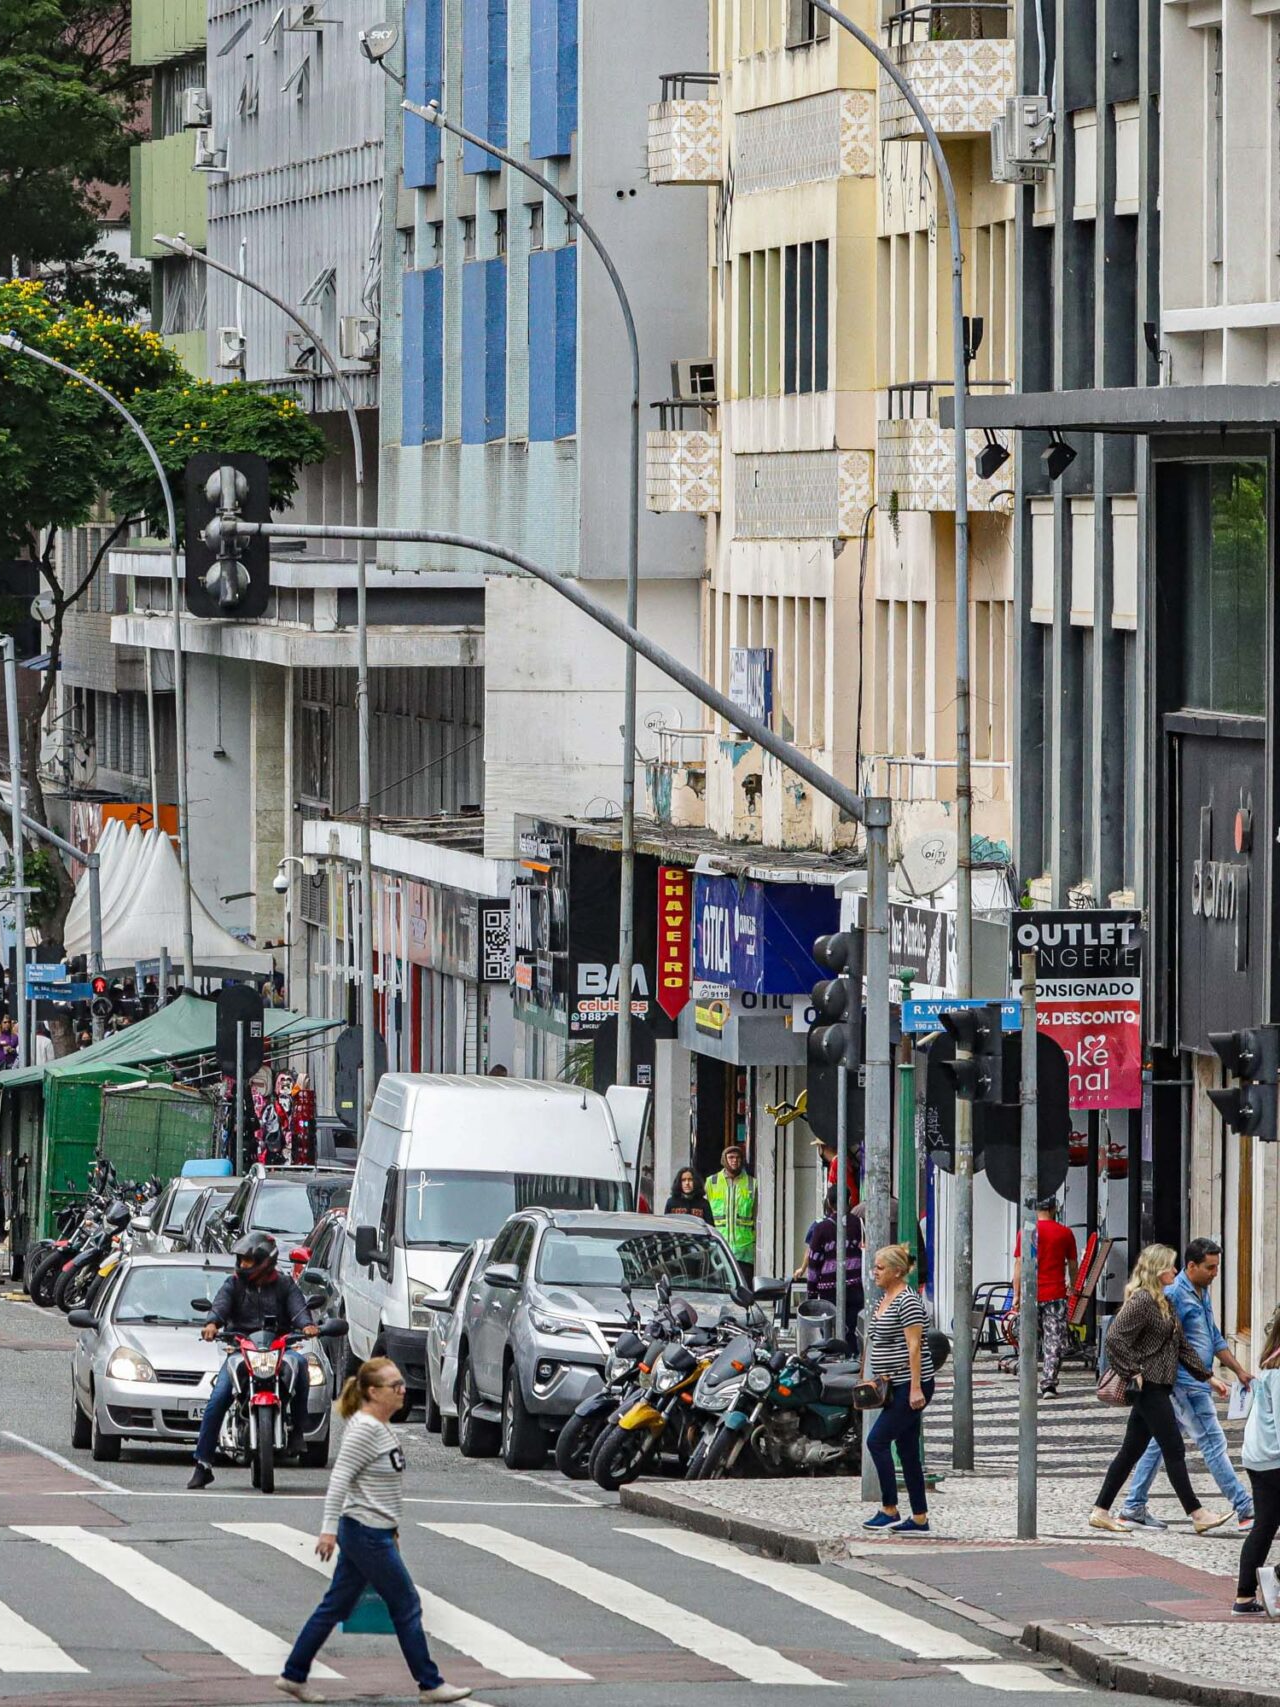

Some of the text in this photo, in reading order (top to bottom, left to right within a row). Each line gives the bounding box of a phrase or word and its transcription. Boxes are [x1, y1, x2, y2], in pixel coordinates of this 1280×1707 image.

[664, 870, 684, 988] CHAVEIRO
[702, 887, 731, 974] ÓTICA
[1017, 923, 1136, 946] OUTLET
[1018, 947, 1136, 968] LNGERIE
[577, 963, 650, 996] BM
[914, 1005, 925, 1014] R.
[927, 1005, 942, 1014] XV
[1052, 1010, 1137, 1025] DESCONTO
